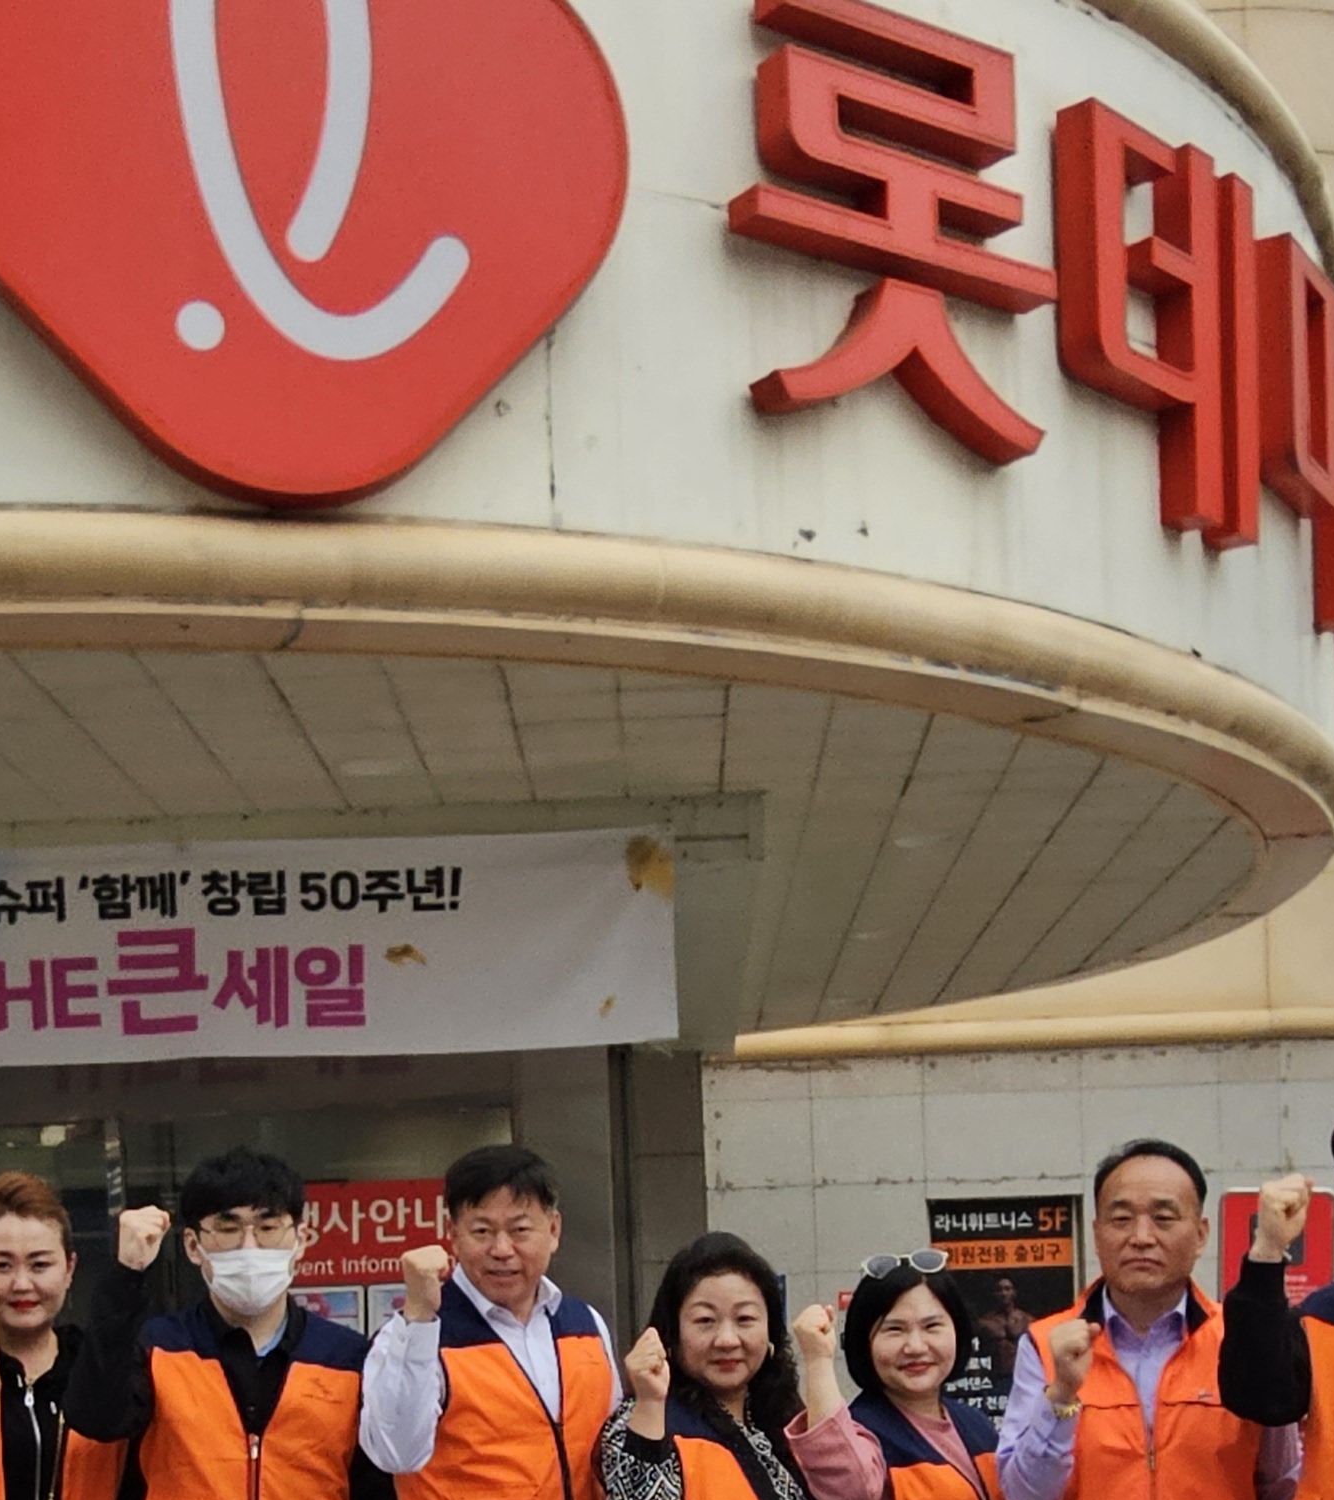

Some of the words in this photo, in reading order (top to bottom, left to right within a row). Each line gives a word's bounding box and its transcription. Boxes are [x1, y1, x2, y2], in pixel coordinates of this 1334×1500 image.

[201, 870, 287, 916] 창립
[300, 866, 463, 913] 50주년!
[1038, 1207, 1069, 1232] 5F
[1013, 1243, 1062, 1262] 출입구
[292, 1256, 335, 1276] vent
